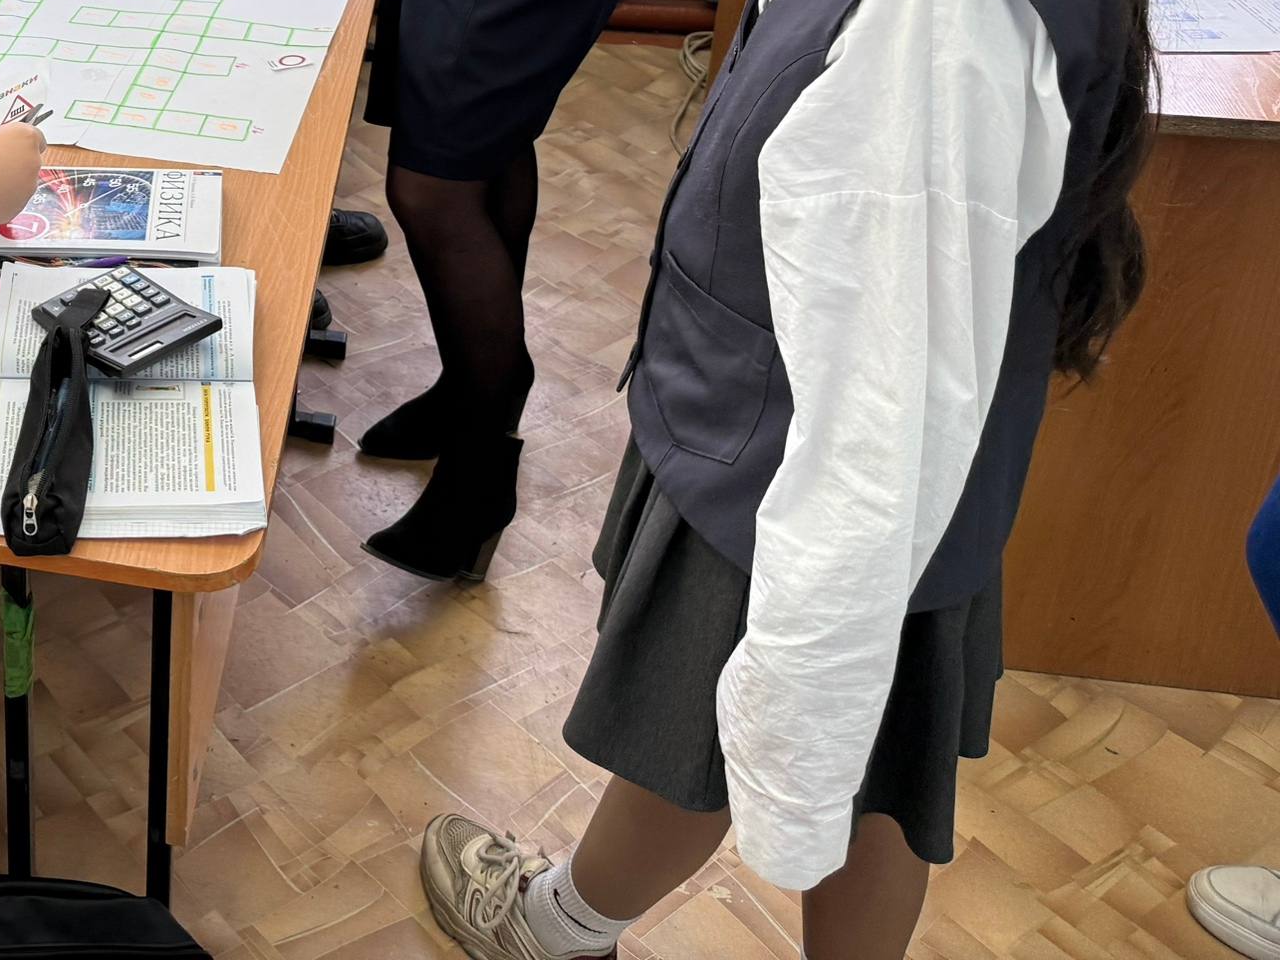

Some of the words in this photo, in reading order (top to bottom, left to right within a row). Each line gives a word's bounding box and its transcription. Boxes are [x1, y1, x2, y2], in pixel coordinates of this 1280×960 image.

[109, 177, 122, 187] 50
[154, 171, 186, 240] ФИЗИКА
[6, 221, 39, 233] 7
